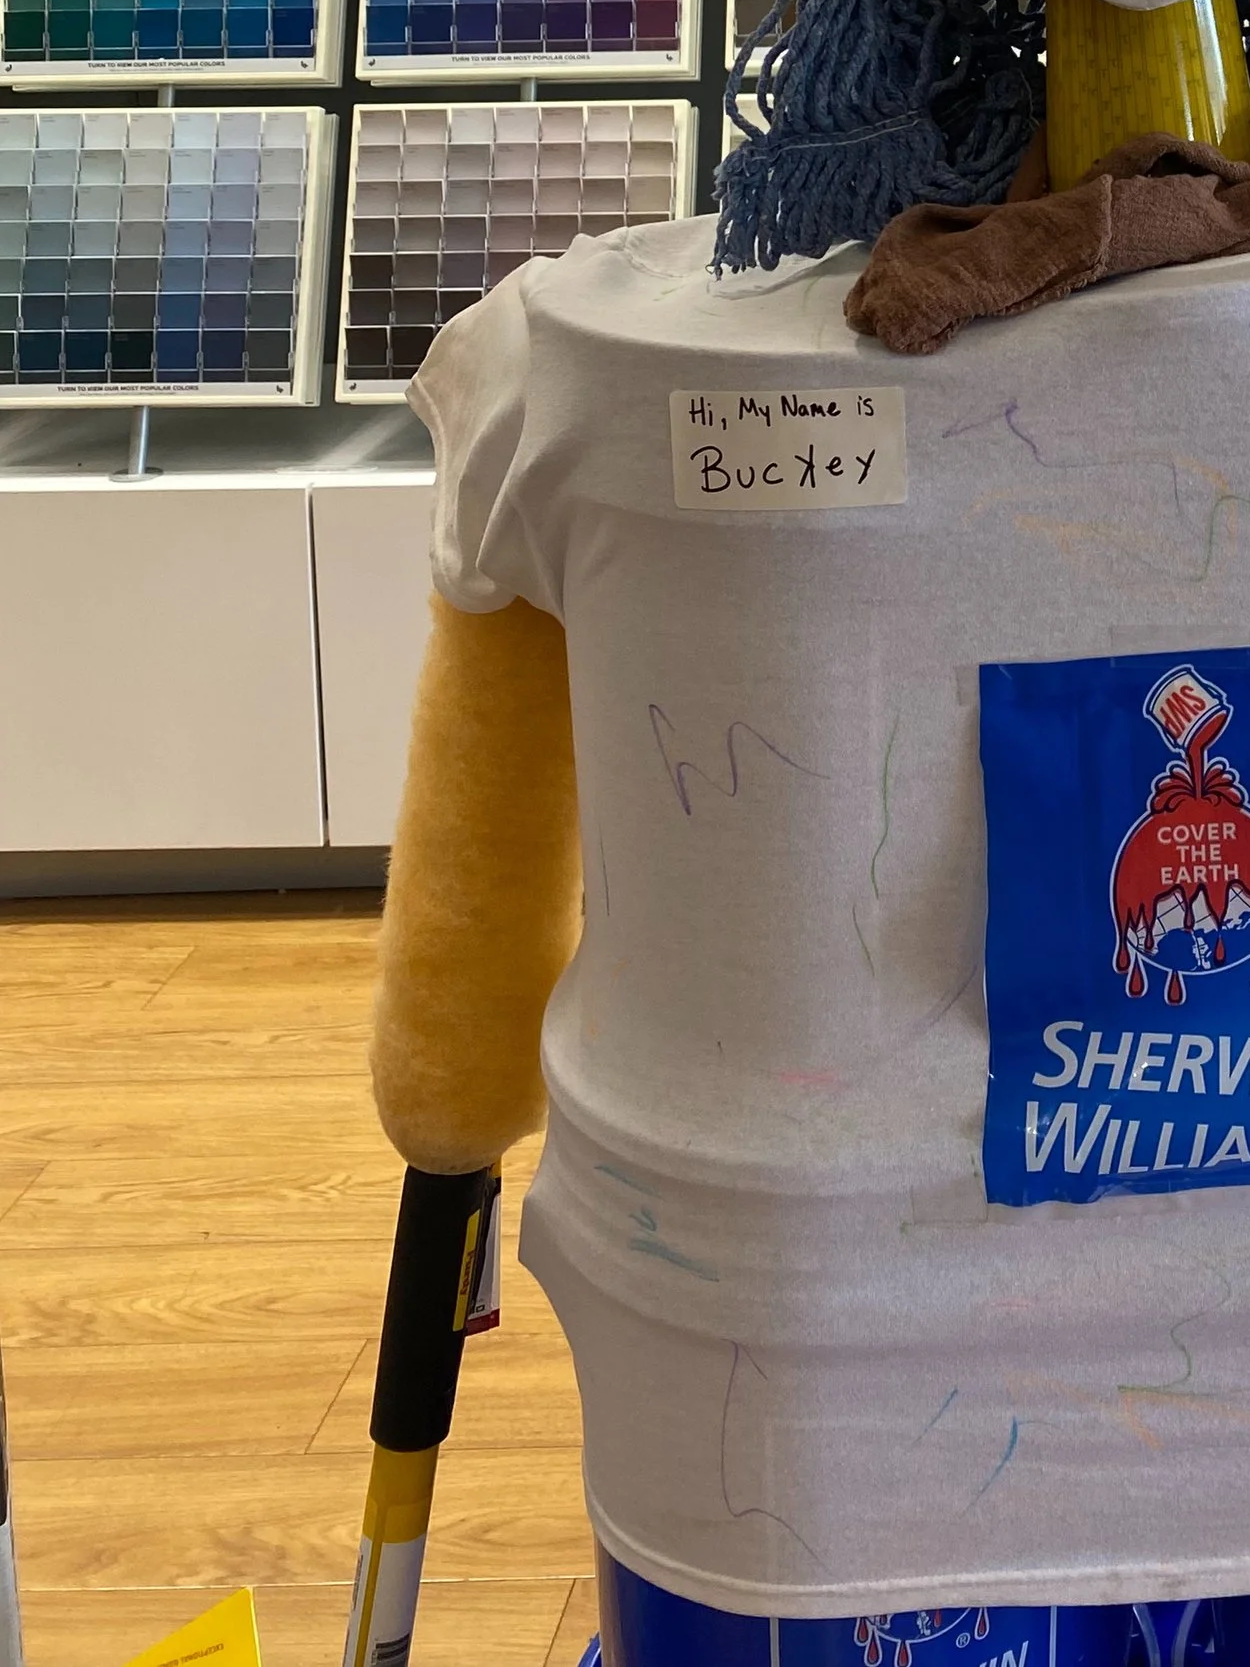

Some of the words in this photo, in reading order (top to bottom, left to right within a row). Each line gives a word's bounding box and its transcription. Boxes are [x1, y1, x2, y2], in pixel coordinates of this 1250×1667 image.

[736, 395, 772, 431] My
[779, 392, 842, 422] Name
[855, 395, 875, 419] is
[1162, 684, 1208, 738] SWP
[1157, 822, 1237, 844] COVER
[1176, 844, 1222, 865] THE
[1160, 863, 1240, 886] EARTH
